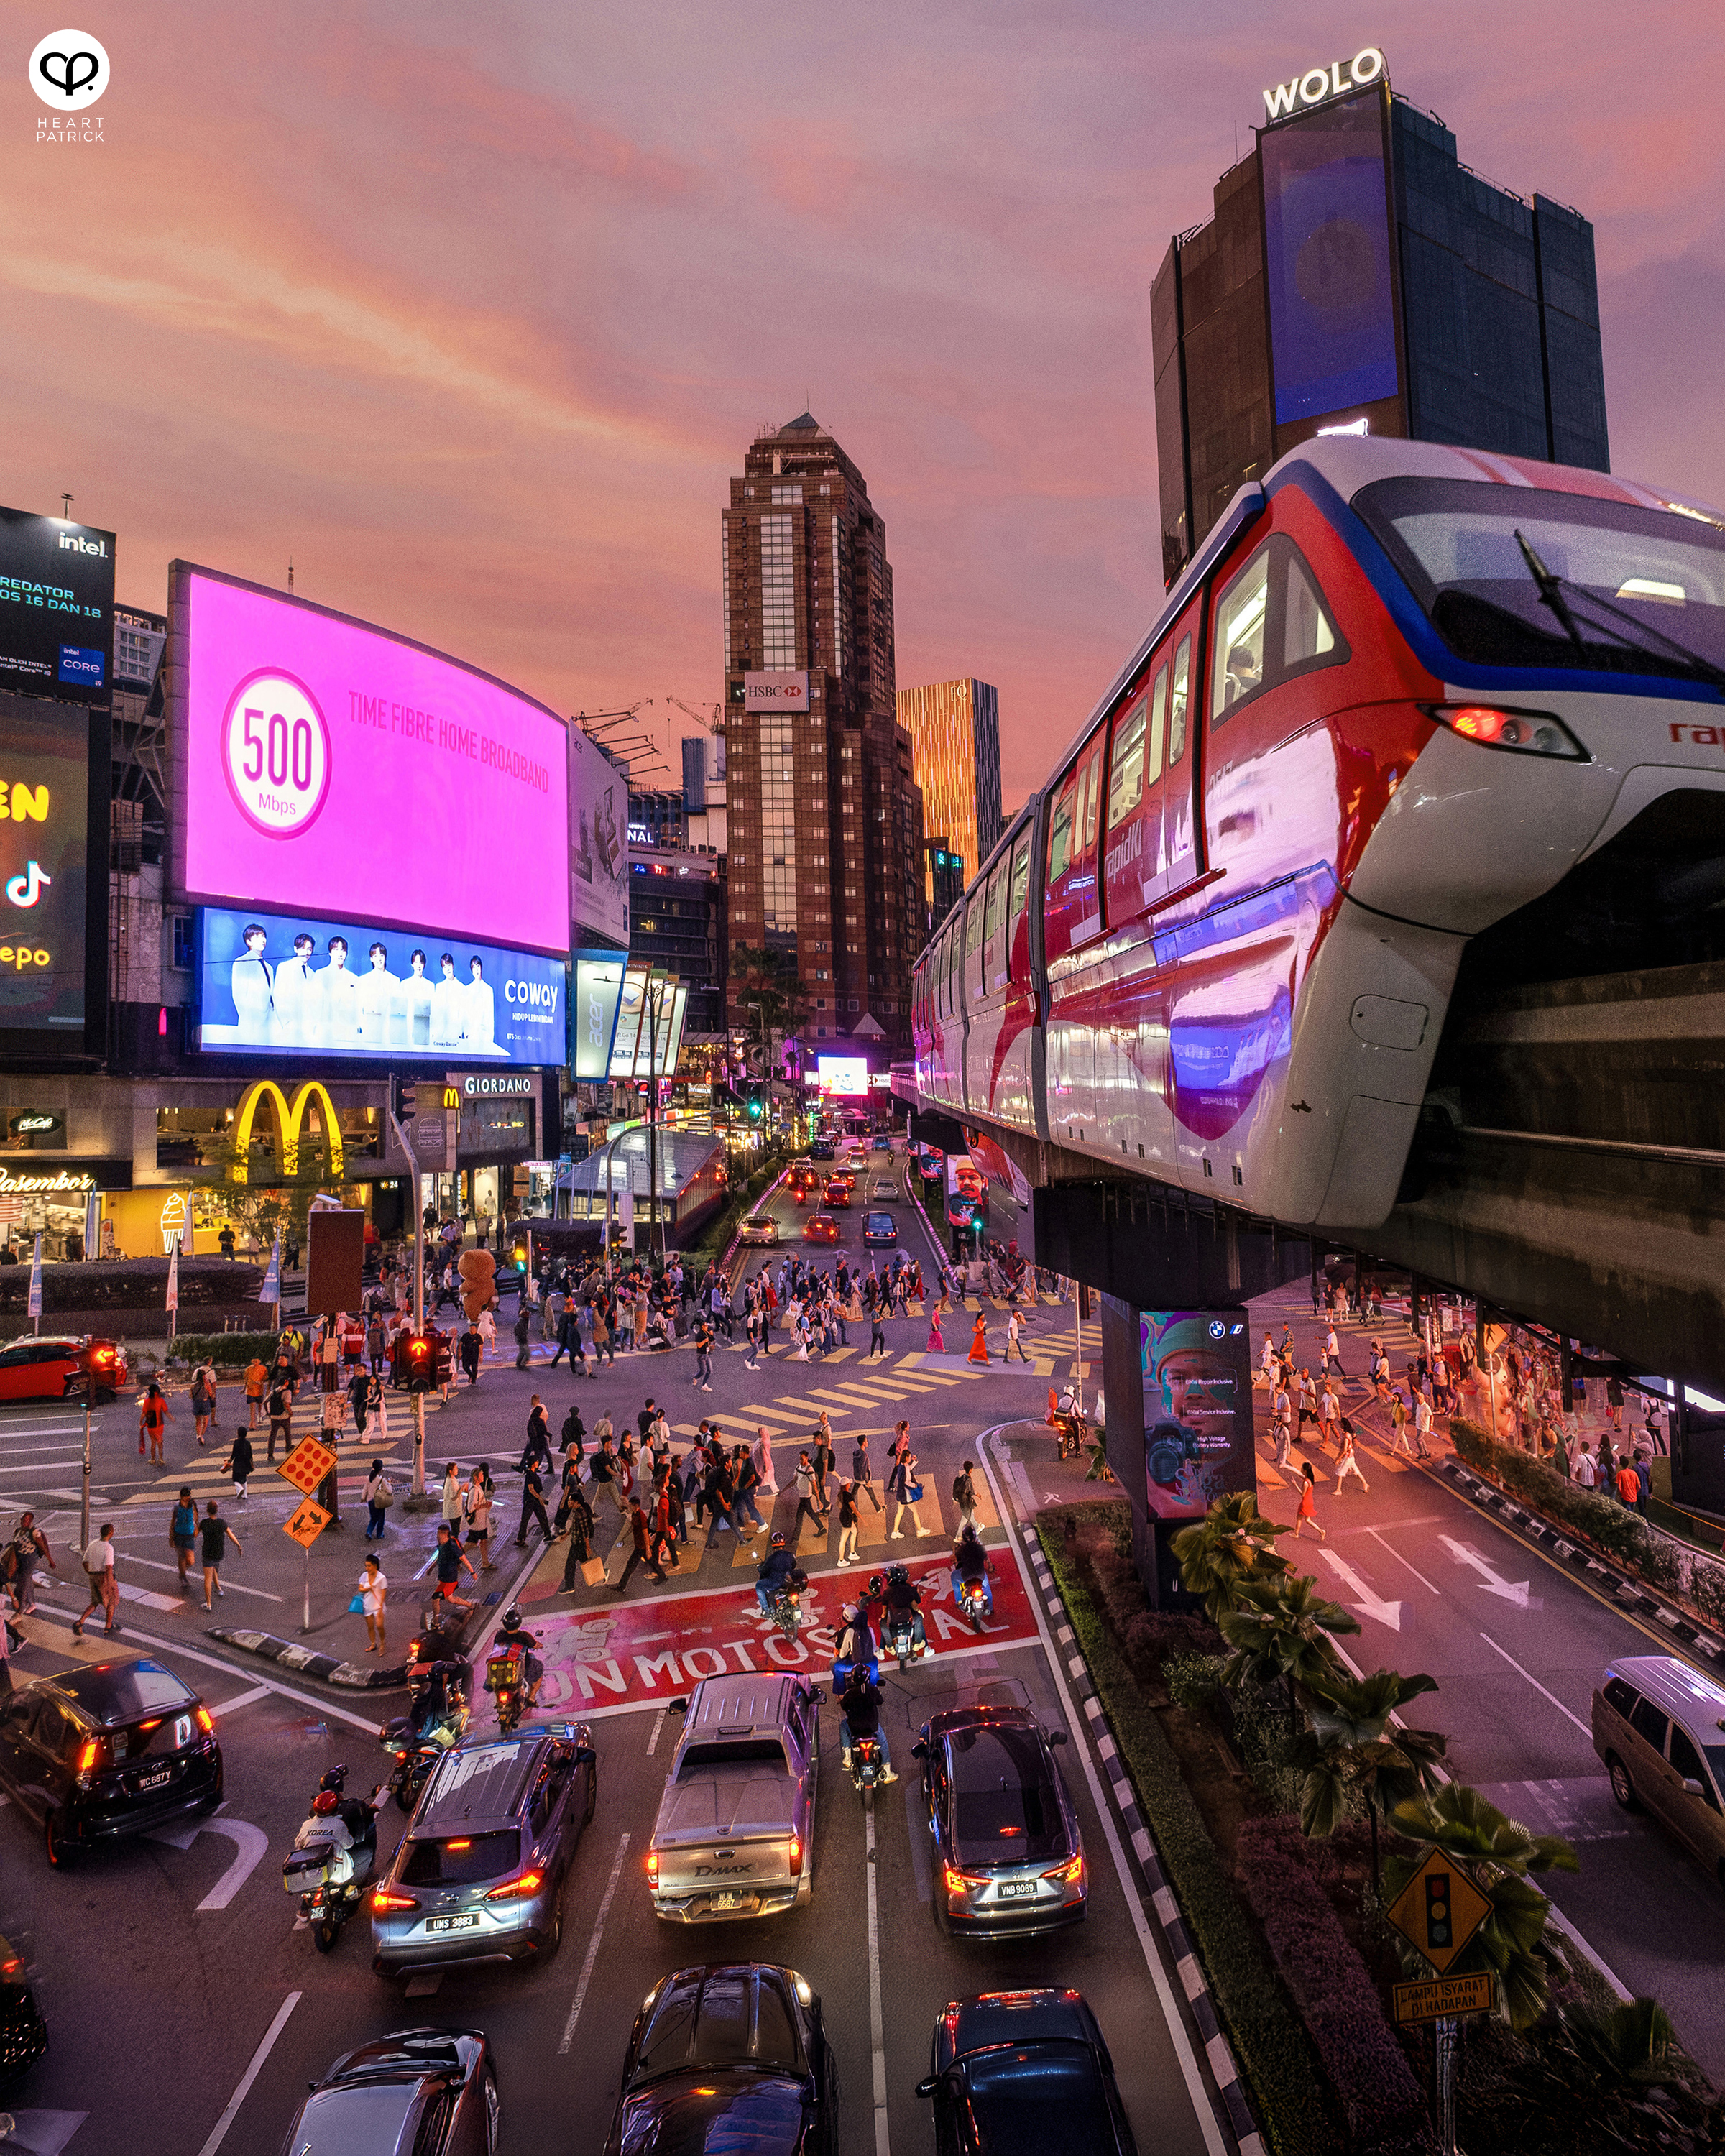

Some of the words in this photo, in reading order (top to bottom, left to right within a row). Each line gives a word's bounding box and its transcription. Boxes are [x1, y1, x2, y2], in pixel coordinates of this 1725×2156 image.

[1263, 47, 1382, 119] WOLO
[25, 594, 43, 606] 16
[48, 599, 80, 614] DAN
[84, 607, 101, 618] 18
[748, 686, 782, 697] HSBC
[951, 684, 967, 702] EQ
[243, 707, 312, 792] 500
[349, 690, 387, 730] TIME
[392, 702, 434, 745] FIBRE
[439, 719, 477, 760] HOME
[481, 735, 548, 794] BROADBAND
[1669, 723, 1725, 753] ra
[259, 793, 297, 817] Mbps
[589, 993, 604, 1048] acer
[465, 1077, 530, 1094] GIORDANO
[452, 1915, 474, 1927] 3883
[1401, 1984, 1438, 2004] LAMPU
[1441, 1979, 1484, 1996] ISYARAT
[1412, 2003, 1423, 2017] DI
[1426, 1995, 1476, 2012] HADAPAN
